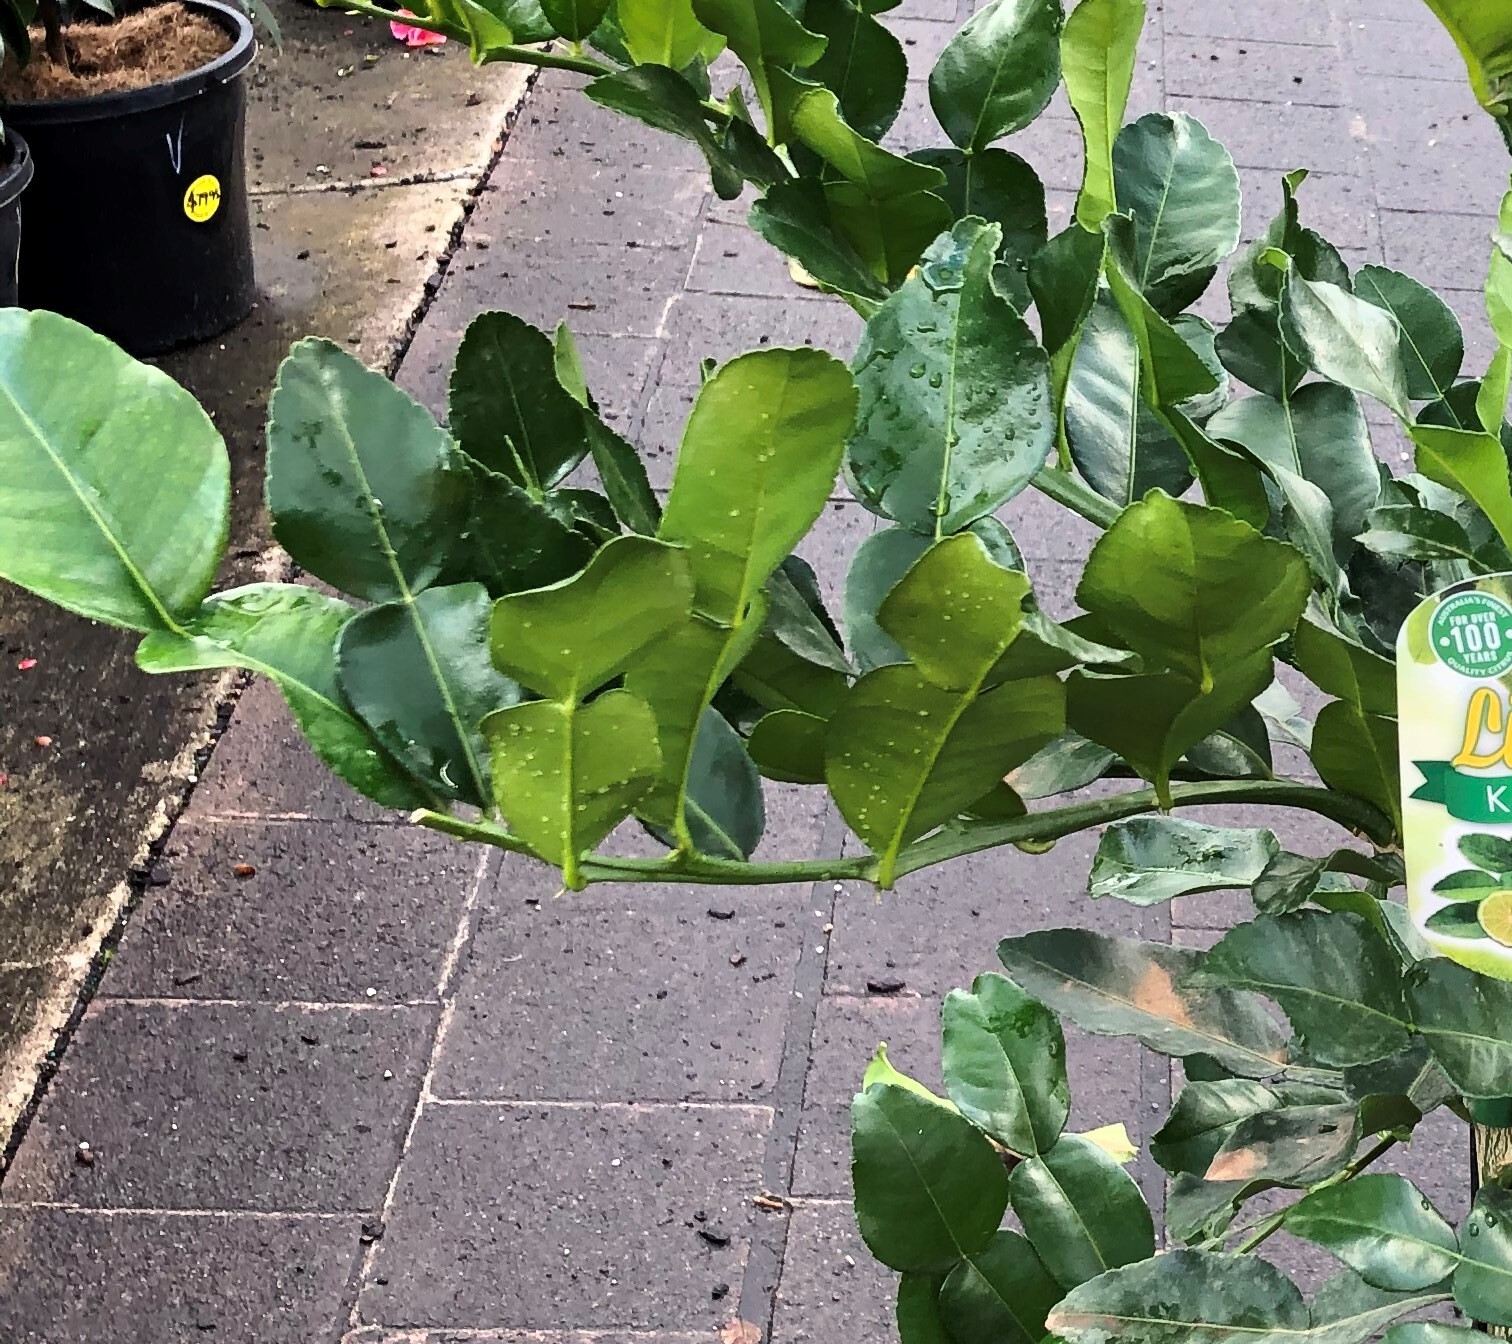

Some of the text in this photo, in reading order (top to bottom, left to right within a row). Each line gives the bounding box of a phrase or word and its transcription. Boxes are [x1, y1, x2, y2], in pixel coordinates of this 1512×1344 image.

[1482, 598, 1509, 618] FINEST
[1449, 611, 1496, 626] FOR OVER
[1450, 622, 1501, 654] 100
[1447, 657, 1487, 675] QUALITY
[1463, 650, 1498, 664] YEARS
